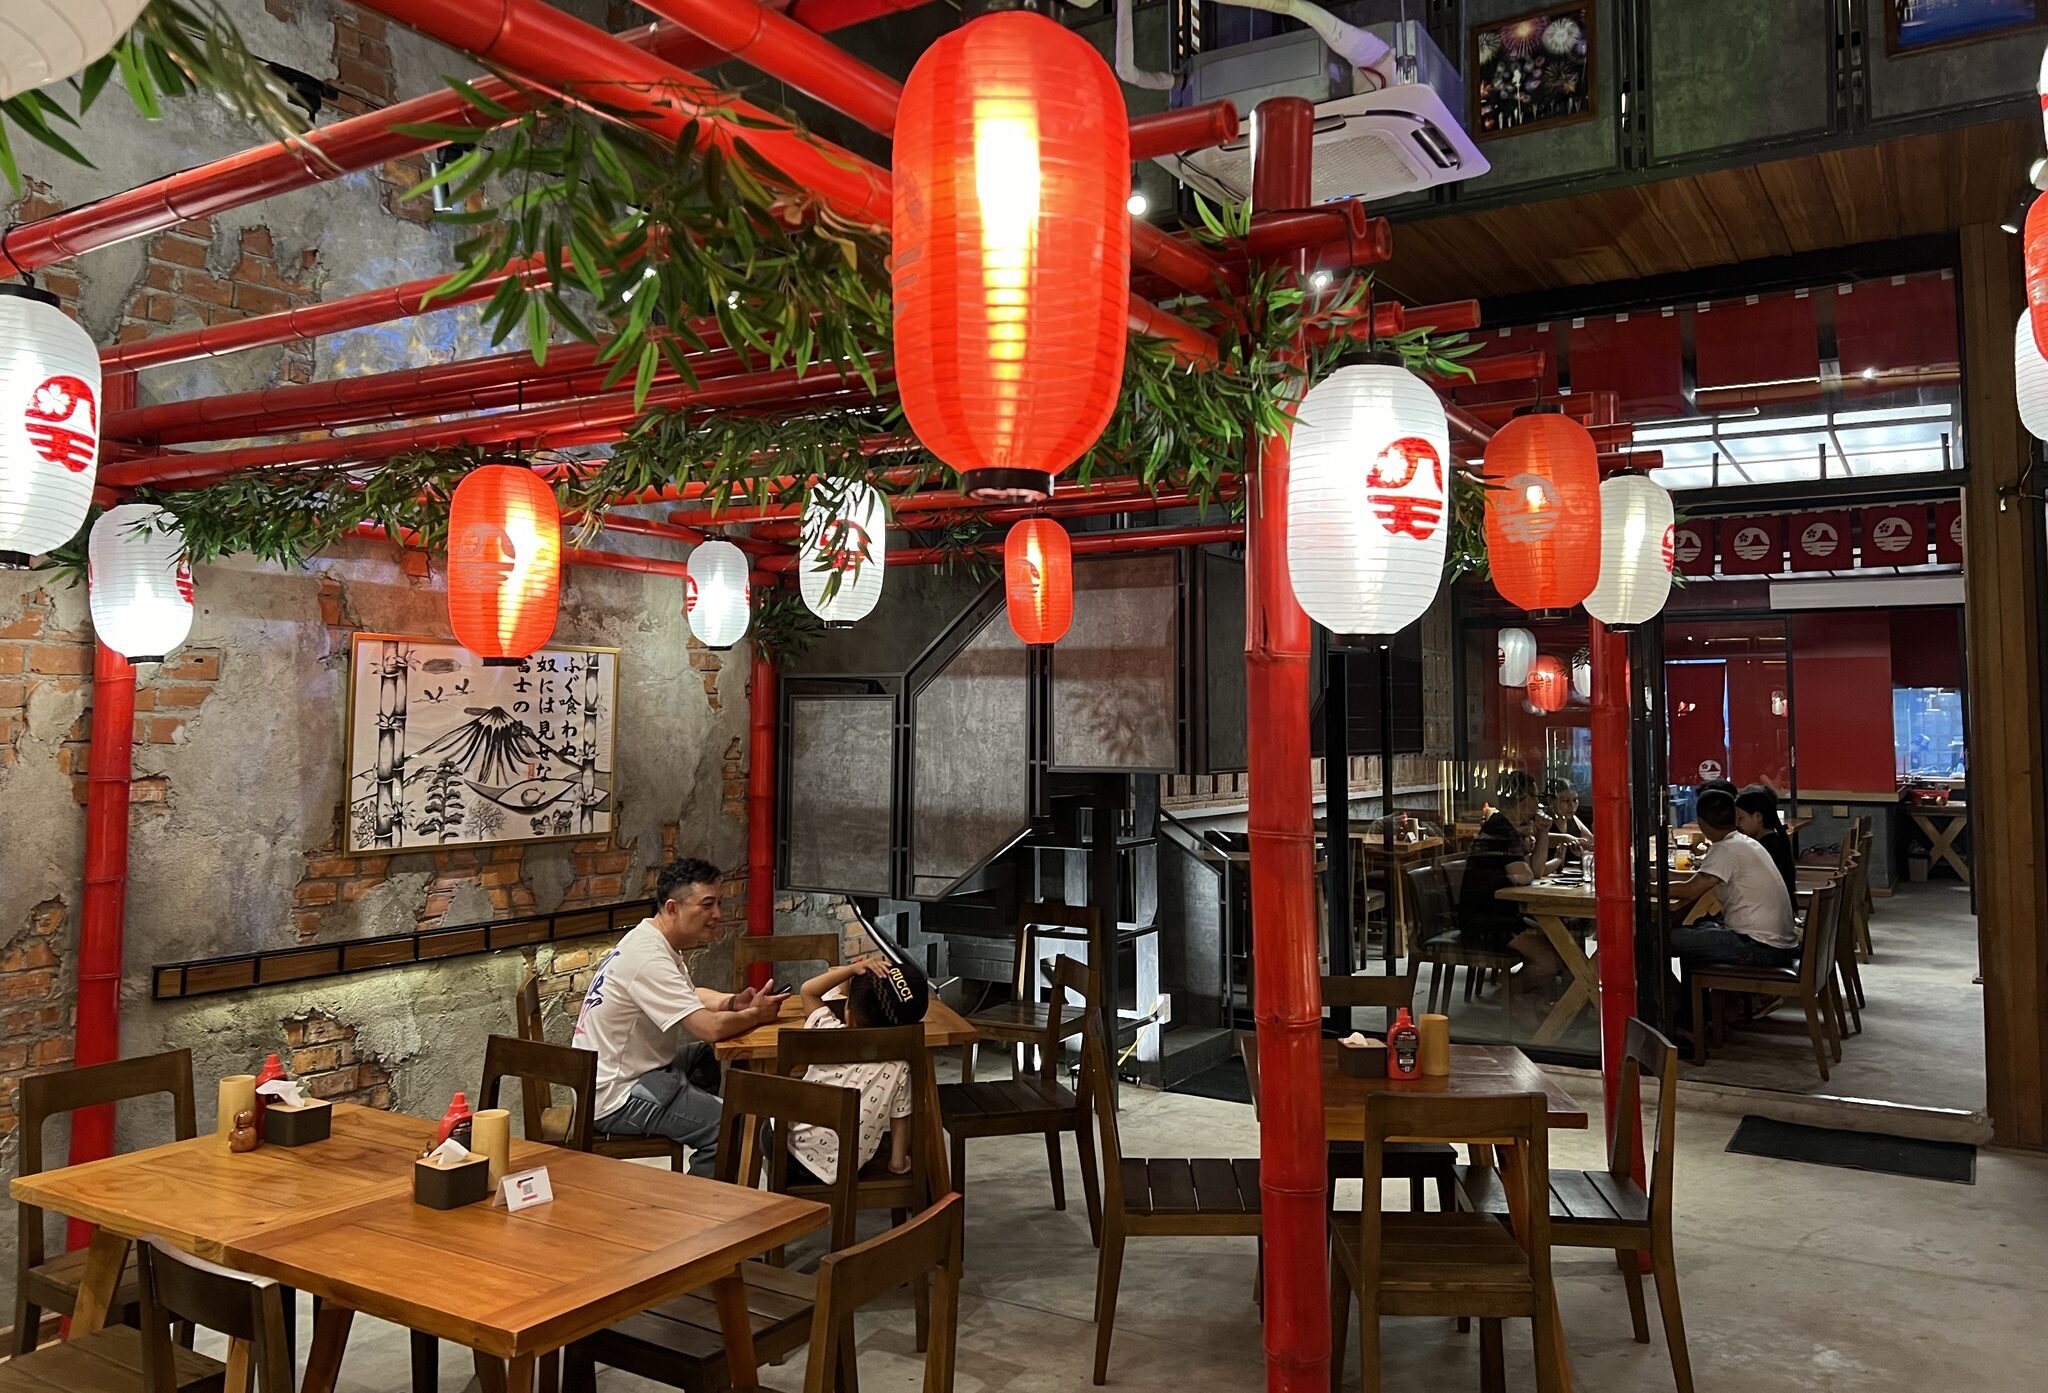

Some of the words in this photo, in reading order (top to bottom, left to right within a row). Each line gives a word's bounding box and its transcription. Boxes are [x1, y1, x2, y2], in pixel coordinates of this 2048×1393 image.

[536, 655, 560, 782] 奴には見せな
[559, 656, 581, 759] ふぐ喰わぬ
[889, 967, 914, 1003] GUCCI
